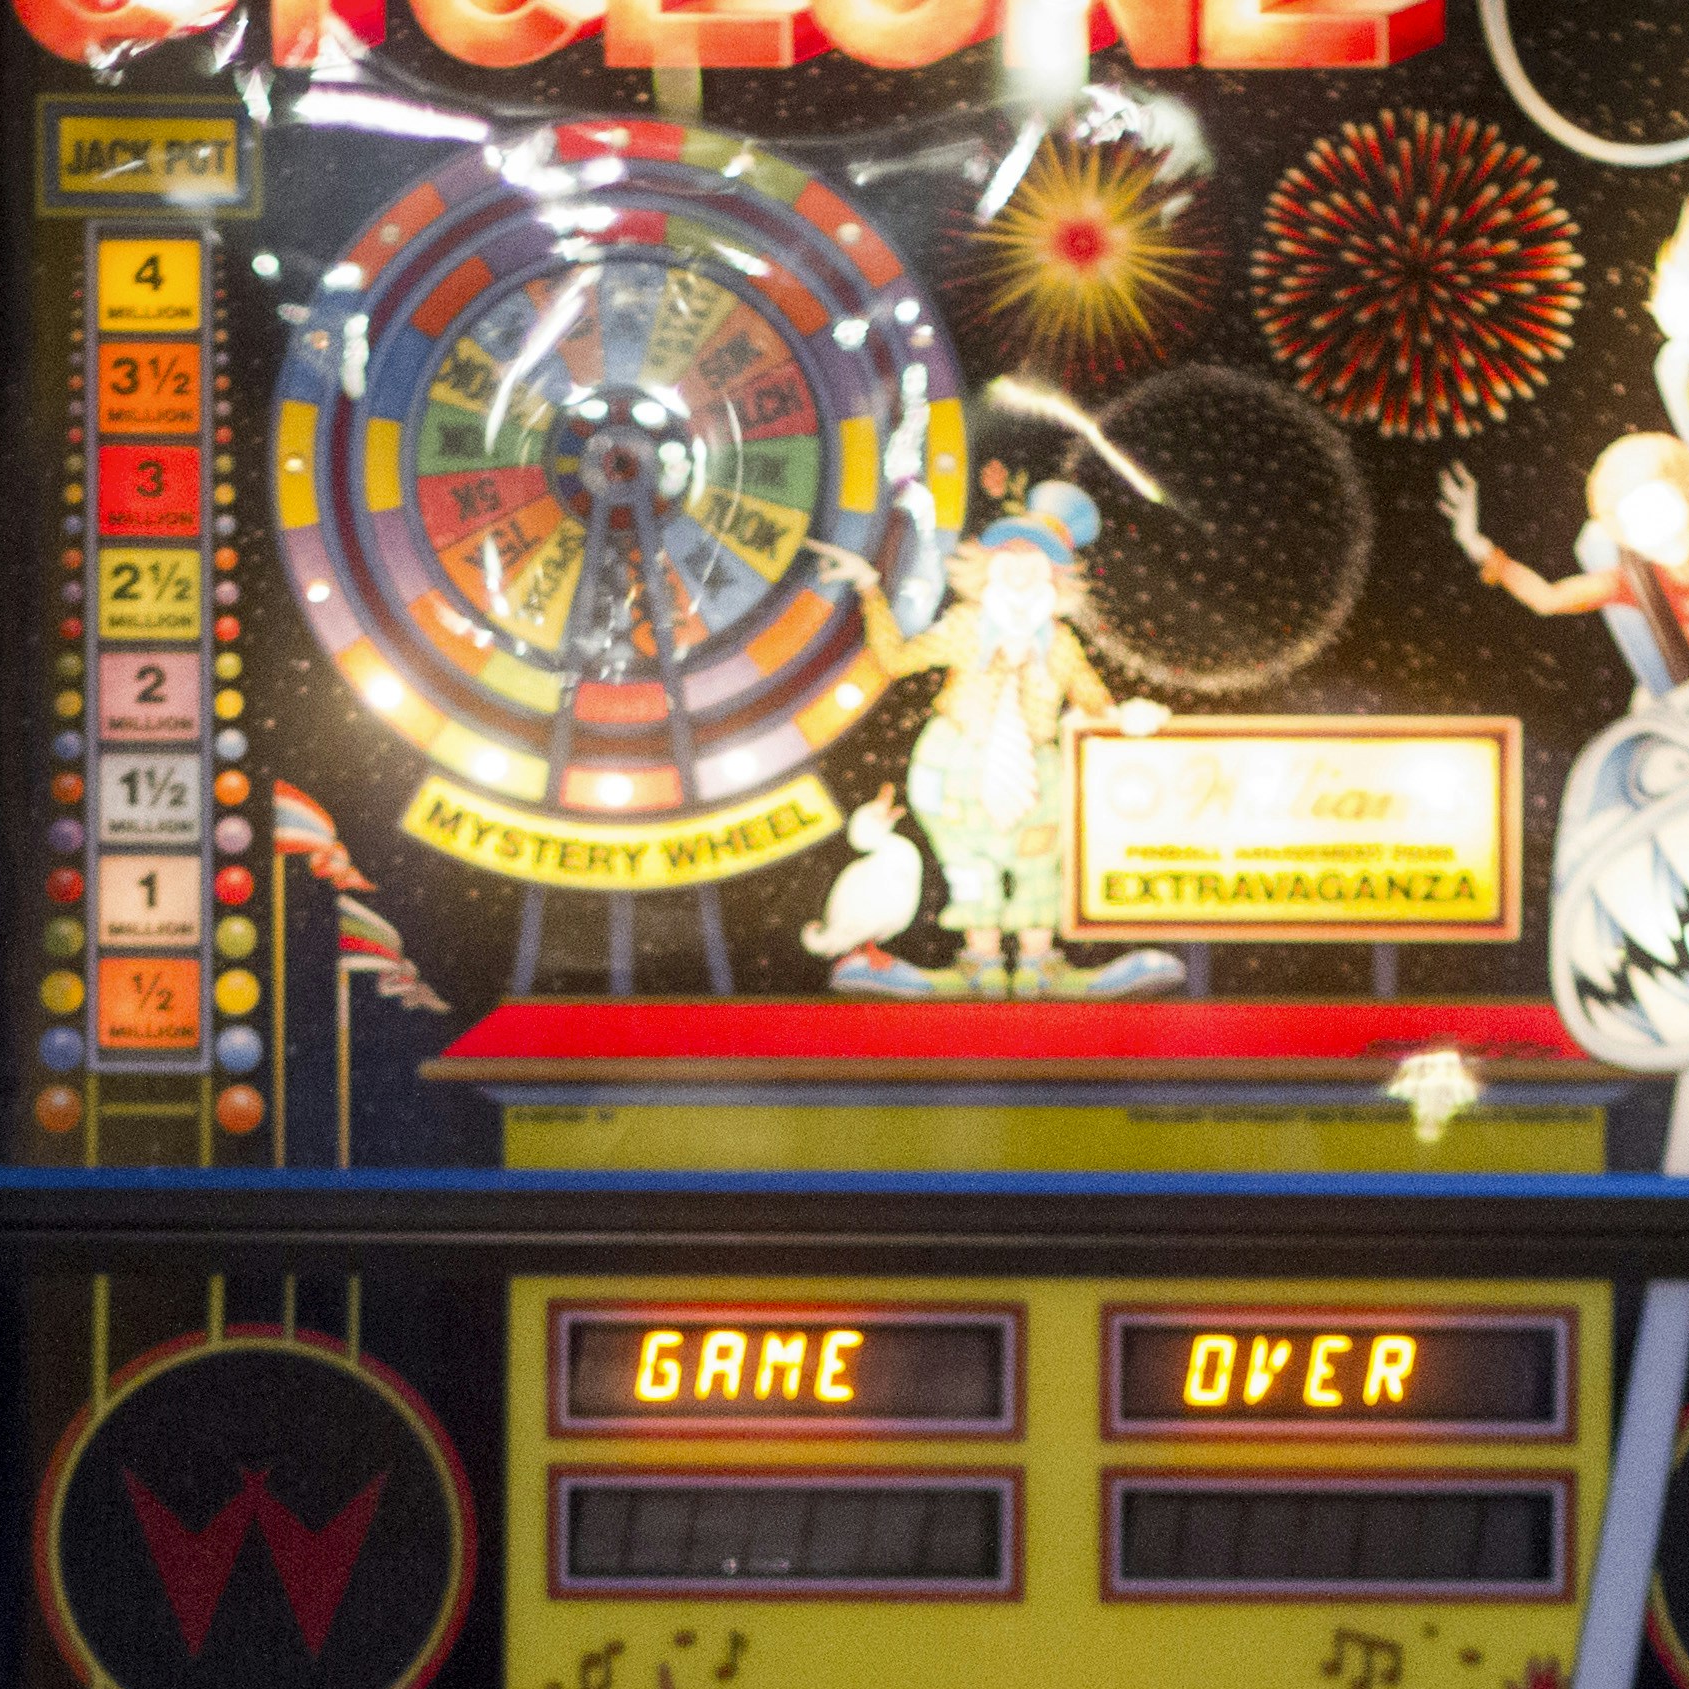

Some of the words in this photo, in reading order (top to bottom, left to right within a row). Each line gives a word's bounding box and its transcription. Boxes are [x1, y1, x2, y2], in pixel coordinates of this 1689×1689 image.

[66, 140, 145, 178] JACK
[134, 254, 164, 291] 4
[136, 460, 165, 498] 3
[135, 665, 167, 704] 2
[426, 799, 649, 877] MYSTERY
[661, 799, 823, 871] WHEEL
[137, 871, 158, 908] 1
[1102, 870, 1478, 903] EXTRAVAGANZA
[633, 1329, 865, 1402] GAME
[1183, 1333, 1418, 1407] OVER
